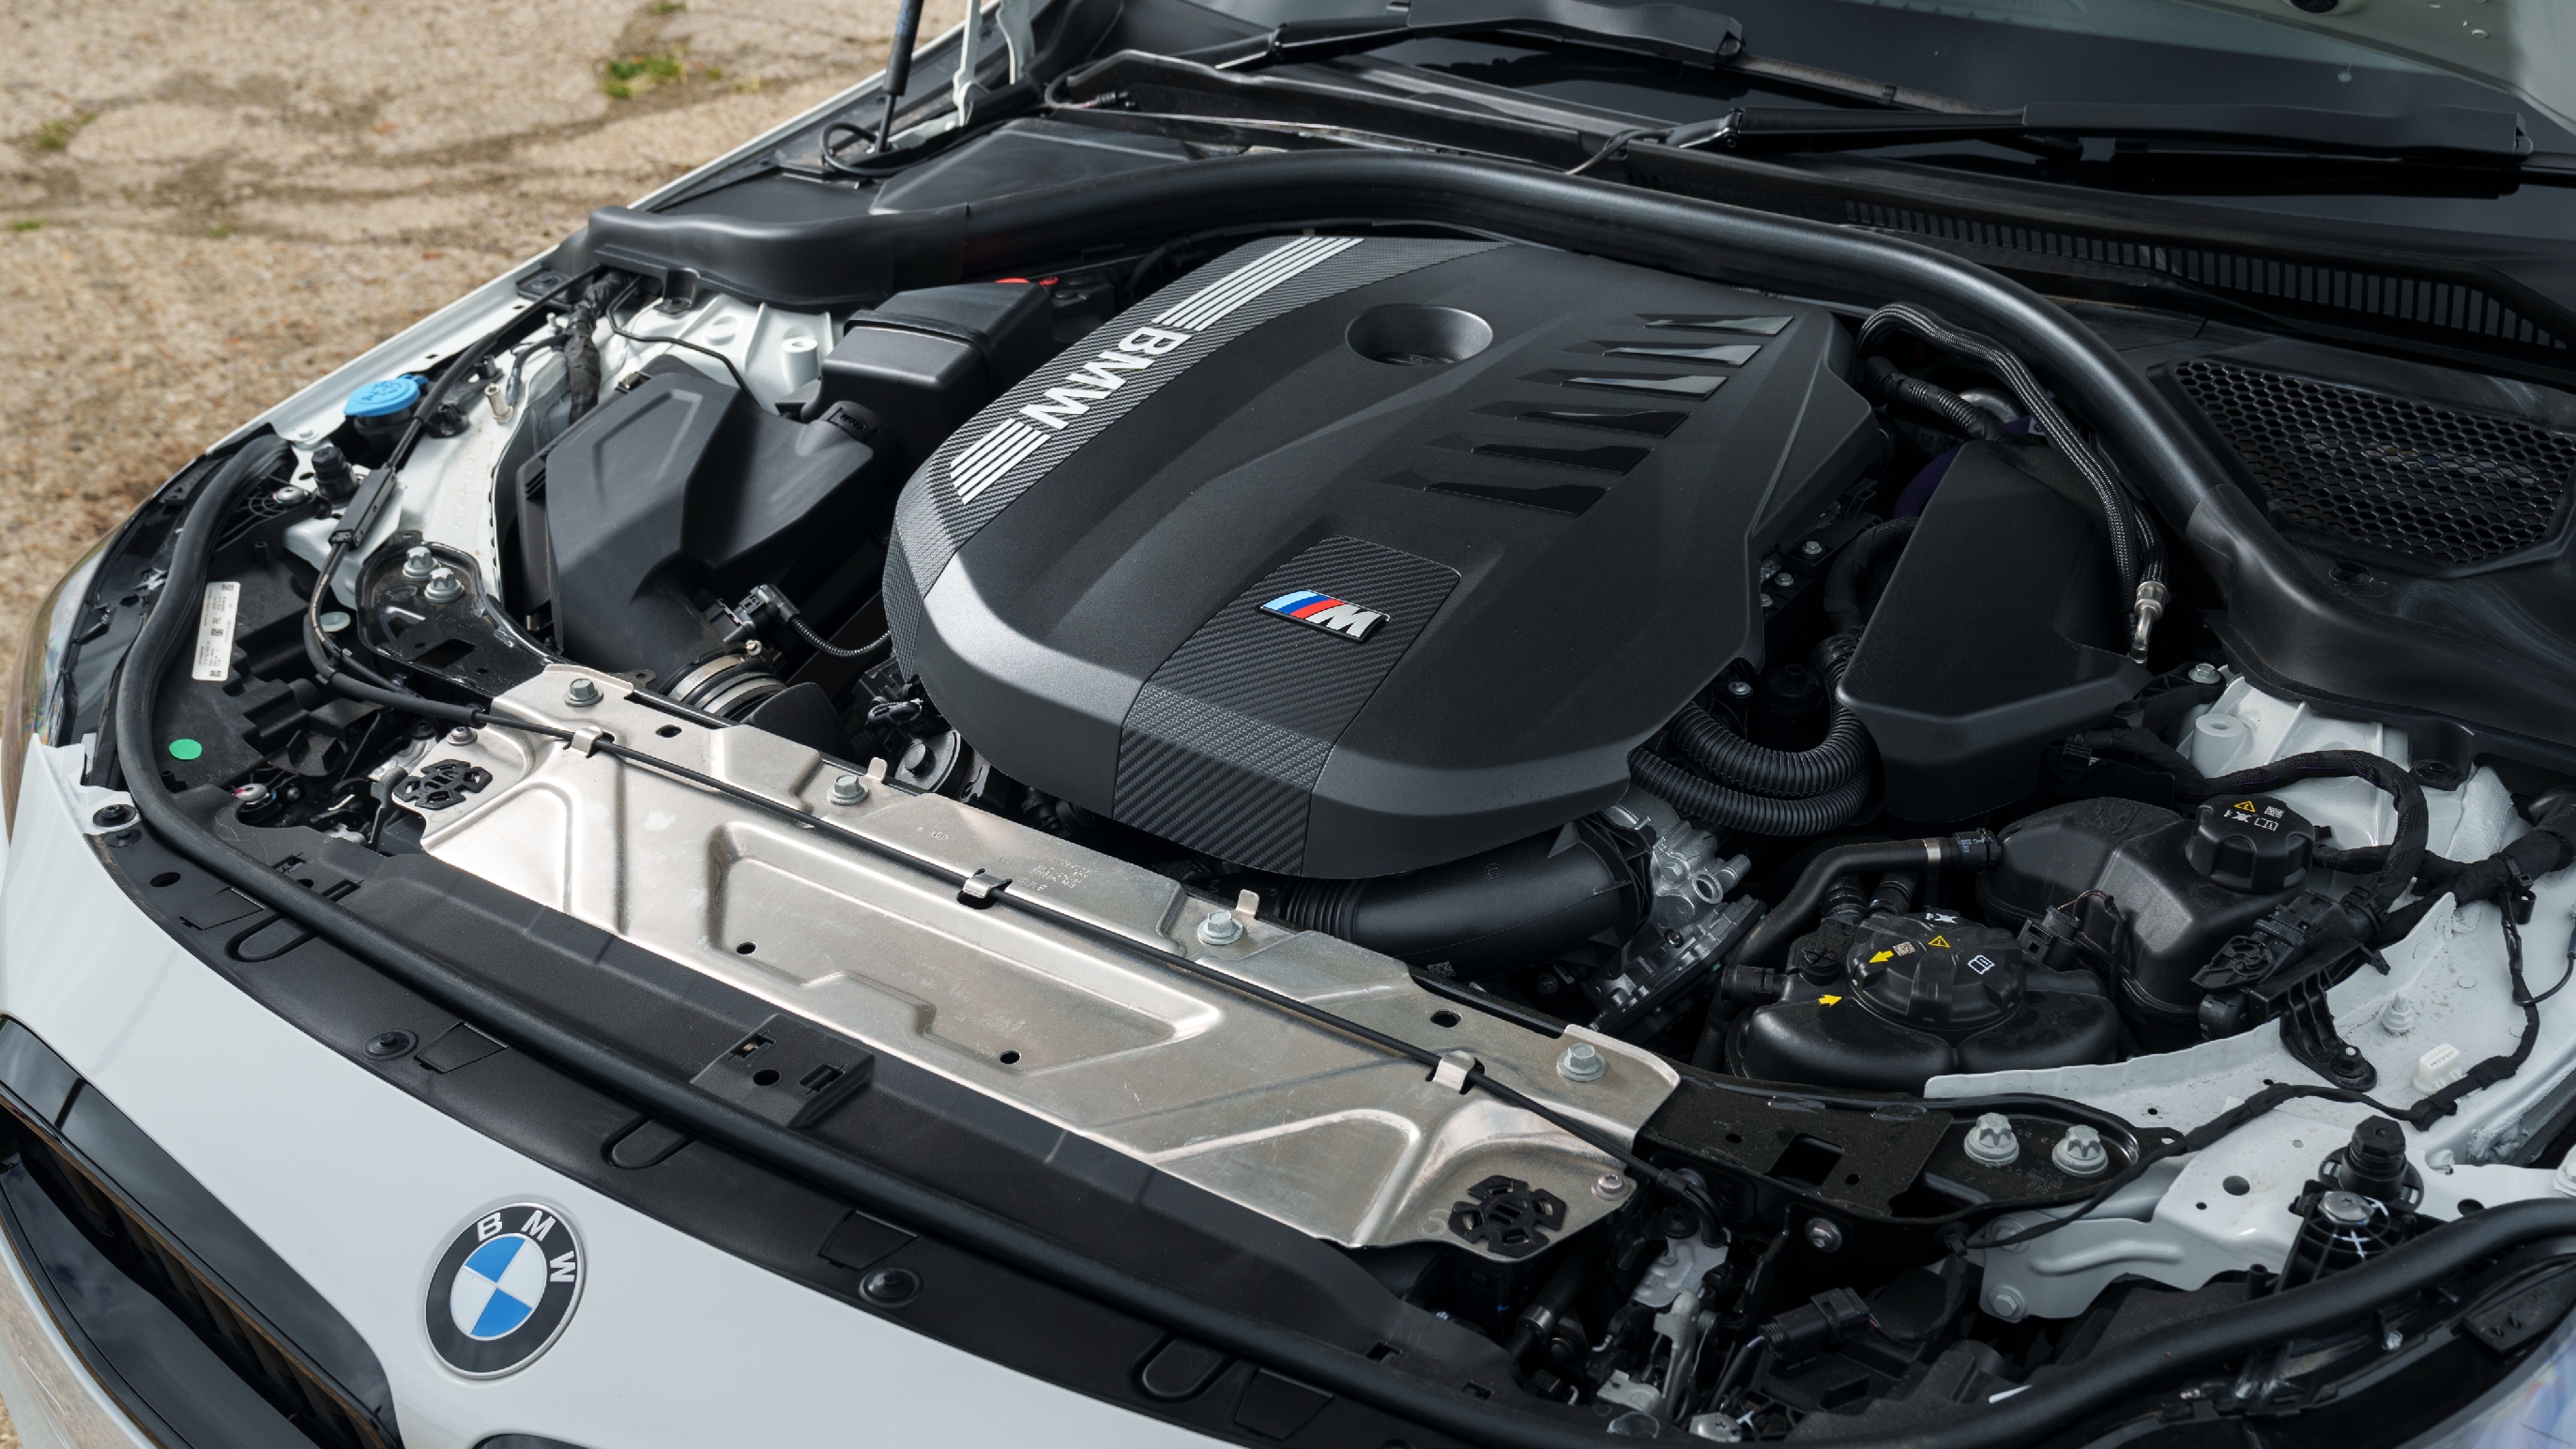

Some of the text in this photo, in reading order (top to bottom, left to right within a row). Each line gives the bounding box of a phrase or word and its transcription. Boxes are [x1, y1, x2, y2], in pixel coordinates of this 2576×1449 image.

[1019, 327, 1192, 431] BMW
[1304, 603, 1382, 638] M
[477, 1210, 576, 1283] BMW
